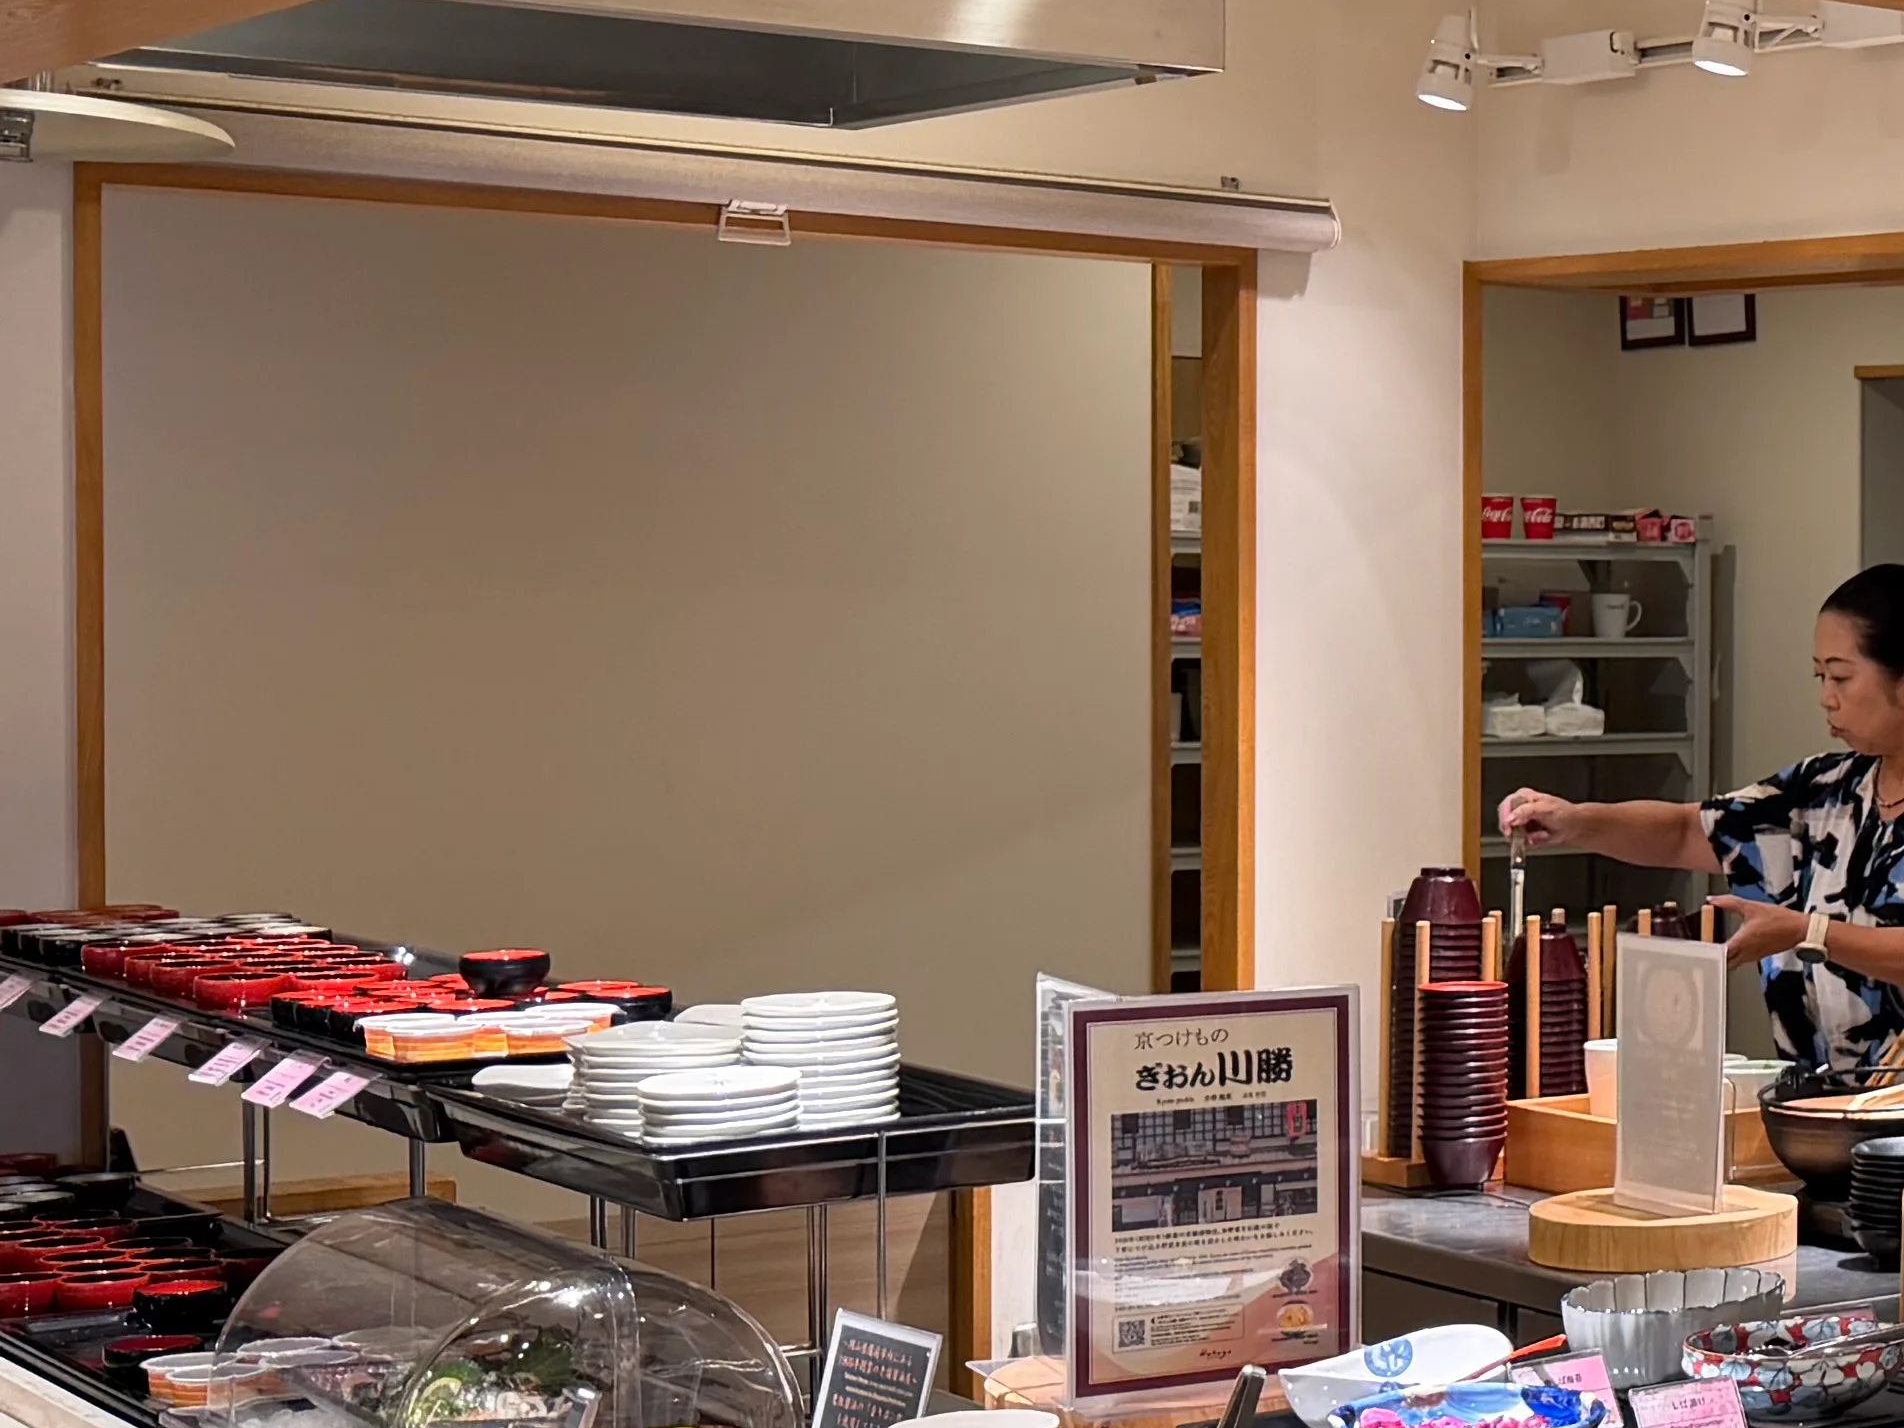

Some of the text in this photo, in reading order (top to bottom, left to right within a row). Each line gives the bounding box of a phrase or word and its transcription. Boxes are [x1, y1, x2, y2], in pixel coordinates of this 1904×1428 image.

[1135, 1028, 1229, 1050] 京つけもの
[1135, 1047, 1293, 1091] ぎおん川勝
